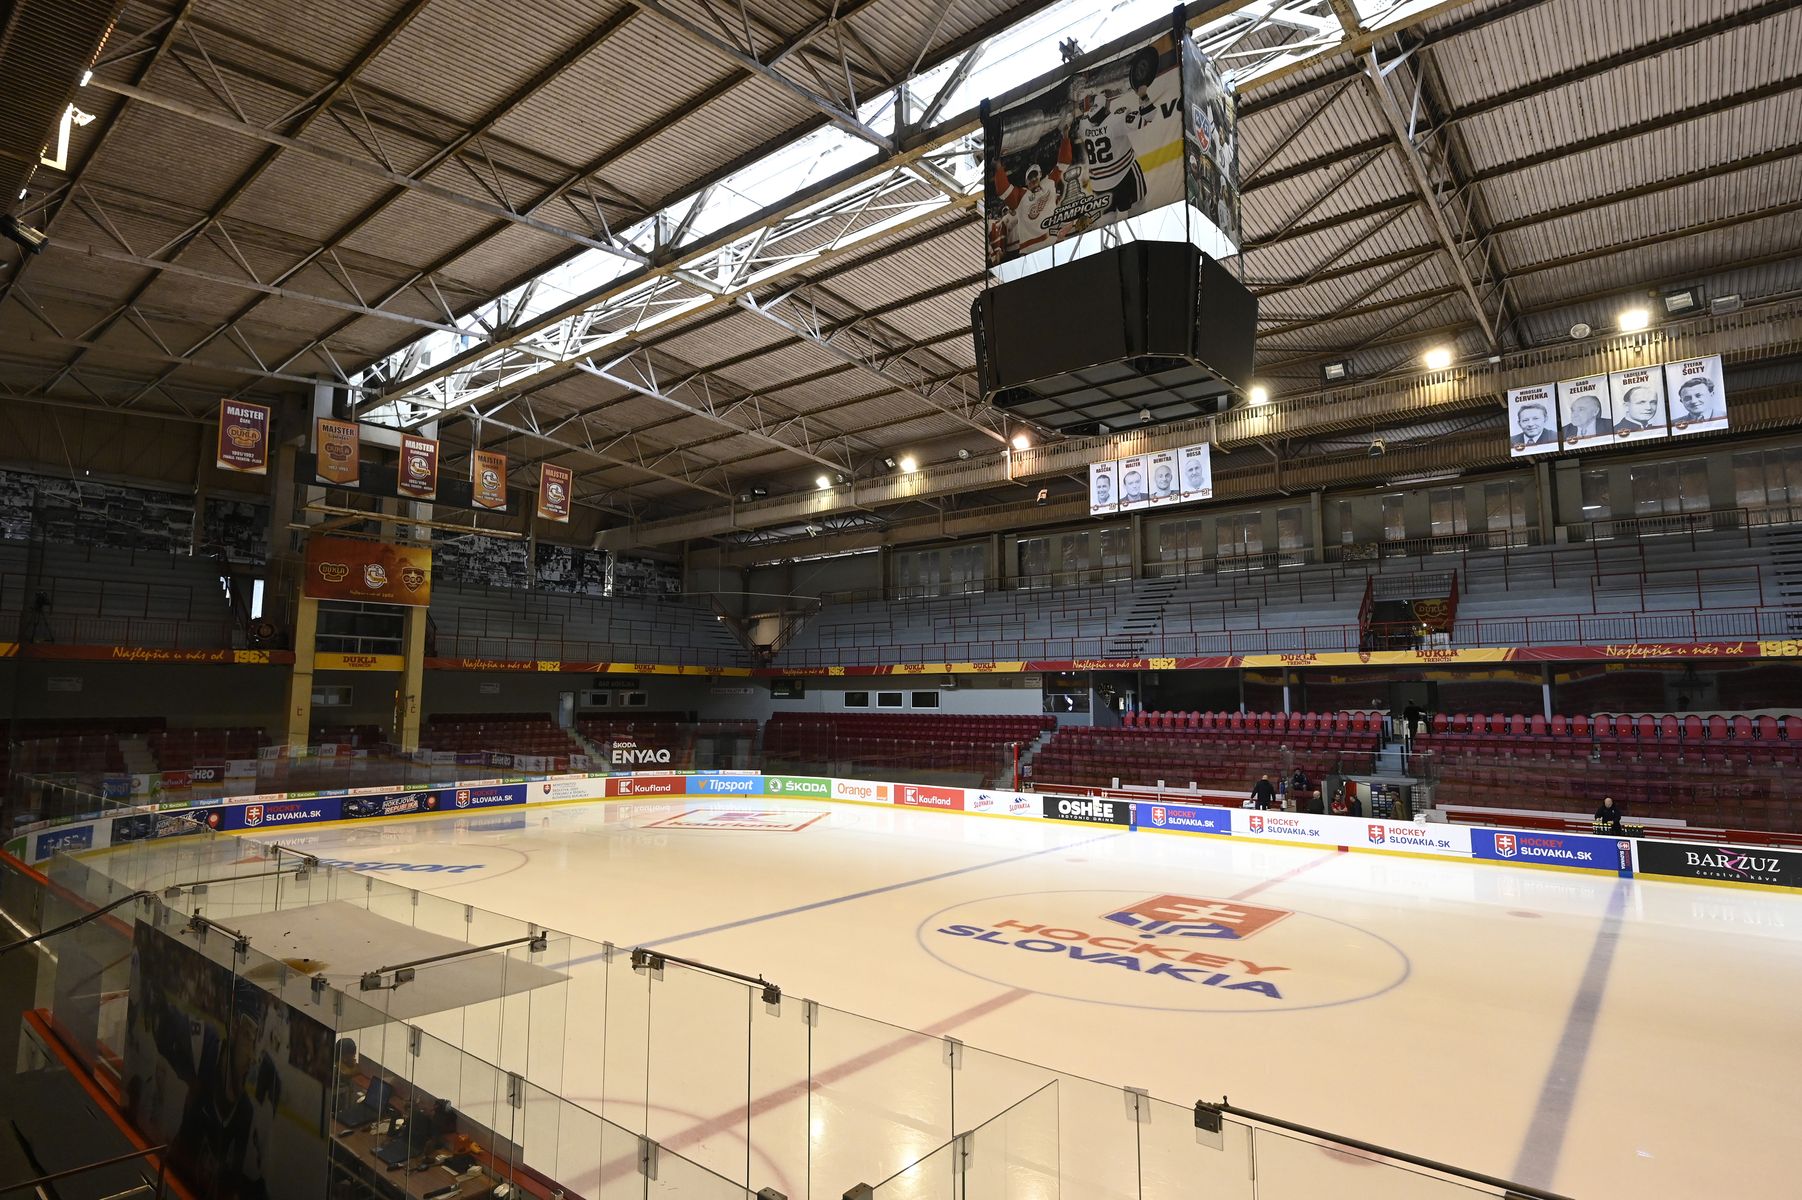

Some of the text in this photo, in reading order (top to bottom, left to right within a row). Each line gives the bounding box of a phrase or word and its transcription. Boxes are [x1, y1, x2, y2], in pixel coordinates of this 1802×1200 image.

[1085, 136, 1113, 164] 82
[1054, 195, 1094, 214] STANLEY CUP
[1041, 195, 1109, 229] CHAMPIONS
[1569, 384, 1596, 394] ZELENAY
[1515, 392, 1548, 402] ČERVENKA
[227, 406, 264, 421] MAJSTER
[231, 429, 257, 439] DUKLA
[322, 424, 354, 436] MAJSTER
[405, 440, 434, 453] MAJSTER
[477, 454, 503, 464] MAJSTER
[545, 468, 569, 480] MAJSTER
[112, 647, 170, 661] Najlepšia
[174, 651, 182, 659] u
[186, 650, 206, 660] nás
[211, 650, 224, 660] od
[1416, 649, 1459, 657] DUKLA
[1606, 644, 1672, 659] Najlepšia
[1691, 645, 1719, 654] nás
[1726, 642, 1744, 654] od
[1280, 653, 1317, 661] DUKLA
[463, 659, 498, 670] Najlepšia
[523, 660, 532, 669] od
[537, 660, 560, 671] 1962
[1072, 659, 1106, 670] Najlepšia
[1133, 659, 1142, 668] od
[1148, 658, 1176, 670] 1962
[828, 666, 845, 676] 1962
[612, 749, 671, 764] ENYAQ
[634, 784, 671, 792] Kaufland
[710, 780, 754, 792] Tipsport
[785, 780, 828, 793] ŠKODA
[837, 783, 872, 798] Orange
[472, 794, 513, 804] SLOVAKIA.SK
[918, 795, 951, 806] Kaufland
[1009, 803, 1030, 812] SLOVAKIA
[1058, 799, 1114, 819] OSHEE
[1168, 809, 1196, 818] HOCKEY
[266, 810, 321, 822] SLOVAKIA.SK
[1168, 817, 1214, 828] SLOVAKIA.SK
[1267, 818, 1299, 827] HOCKEY
[1267, 826, 1320, 837] SLOVAKIA.SK
[1389, 828, 1426, 837] HOCKEY
[1390, 836, 1450, 848] SLOVAKIA.SK
[1520, 837, 1563, 848] HOCKEY
[1520, 846, 1592, 860] SLOVAKIA.SK
[1696, 870, 1740, 879] čerstvá
[992, 919, 1291, 976] HOCKEY
[937, 924, 1283, 999] SLOVAKIA
